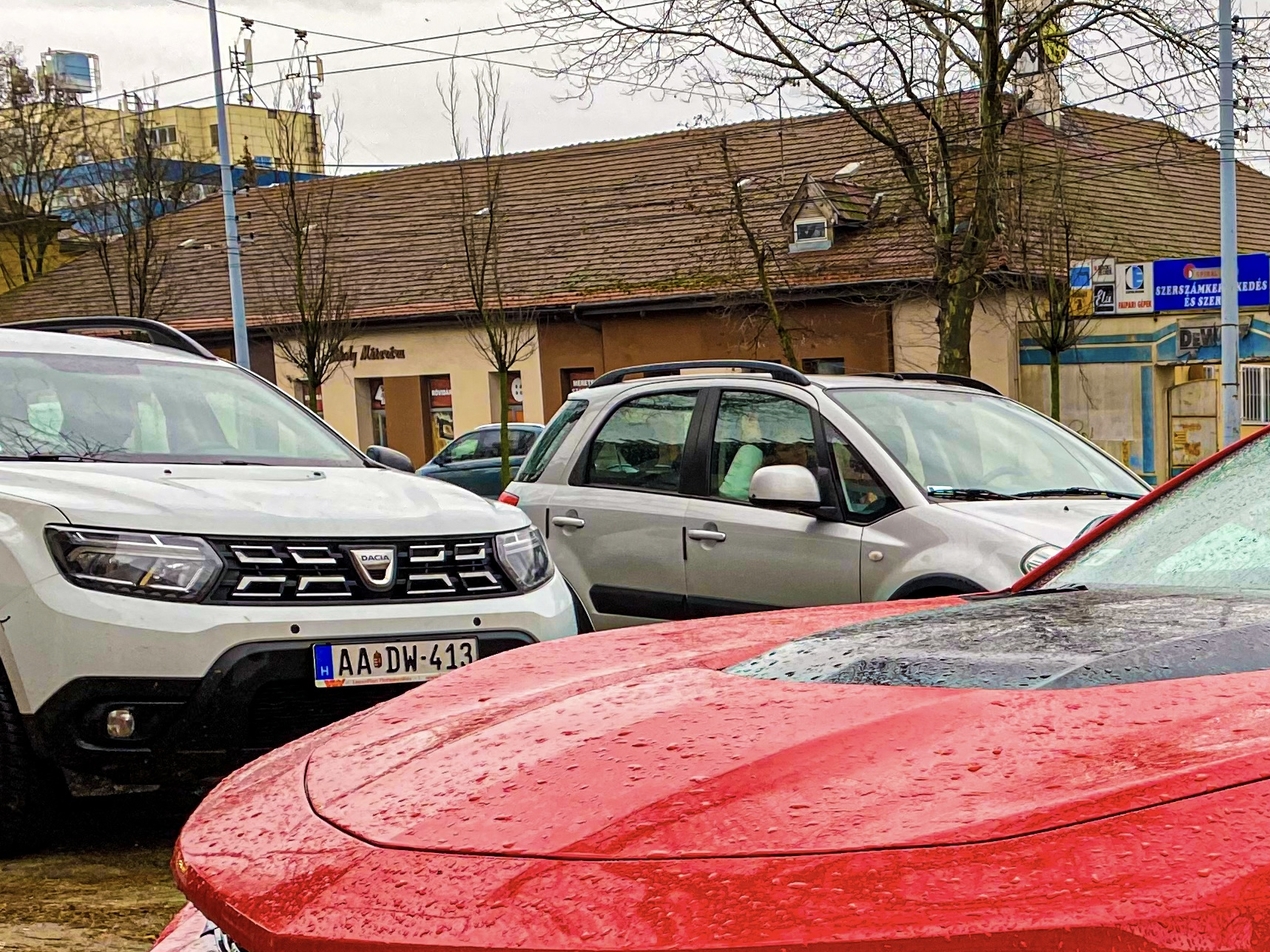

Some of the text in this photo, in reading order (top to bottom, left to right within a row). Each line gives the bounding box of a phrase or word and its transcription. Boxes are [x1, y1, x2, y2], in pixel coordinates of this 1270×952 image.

[1155, 278, 1268, 296] SZERSZÁMKEKEDÉS
[1184, 295, 1196, 307] ÉS
[361, 554, 391, 562] DACIA
